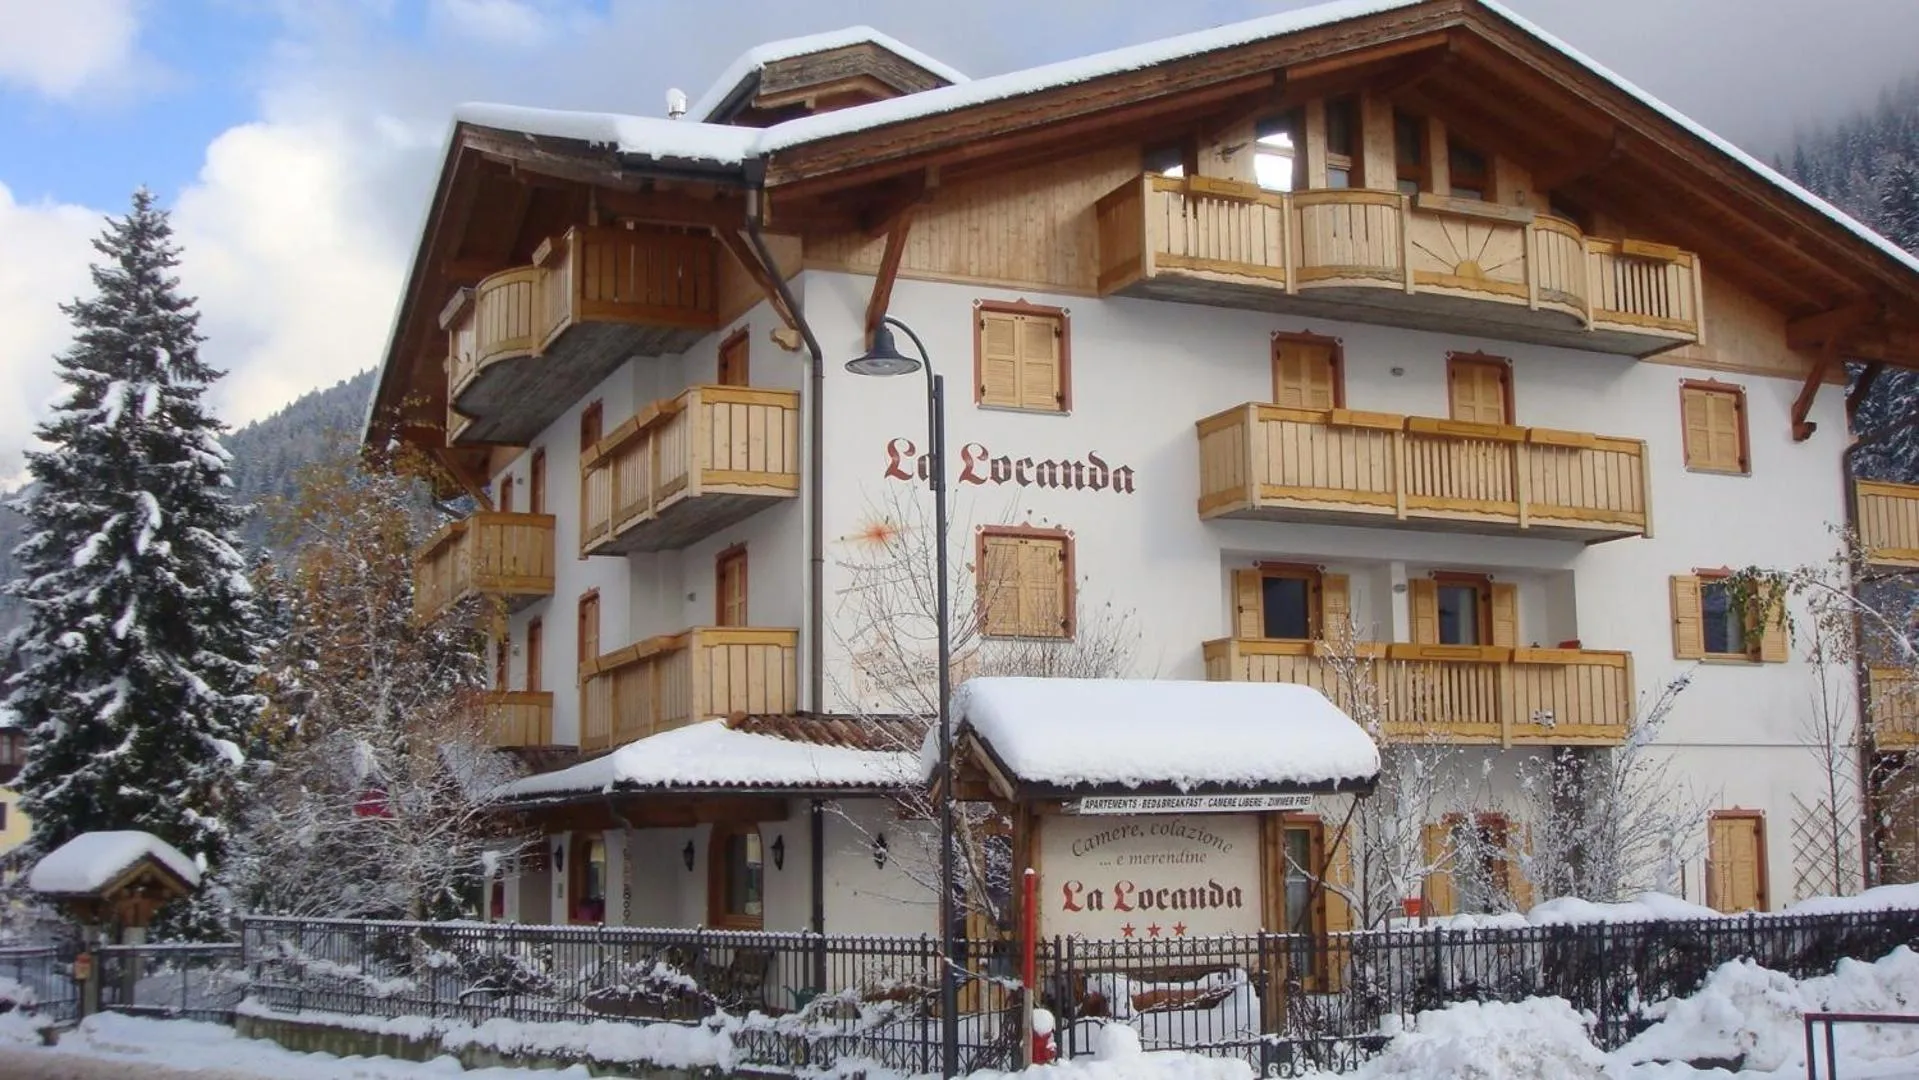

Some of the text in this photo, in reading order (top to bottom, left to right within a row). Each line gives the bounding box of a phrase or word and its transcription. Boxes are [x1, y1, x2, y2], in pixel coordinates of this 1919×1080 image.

[958, 442, 1135, 494] Locanda
[1208, 797, 1236, 808] CAMERE
[1239, 797, 1262, 807] LIBERE
[1267, 796, 1293, 807] ZIMMER
[1295, 795, 1312, 806] FREI
[1072, 818, 1233, 858] Camere, colazione
[1116, 854, 1125, 866] e
[1129, 849, 1208, 866] merendine
[1062, 878, 1243, 913] La Locanda
